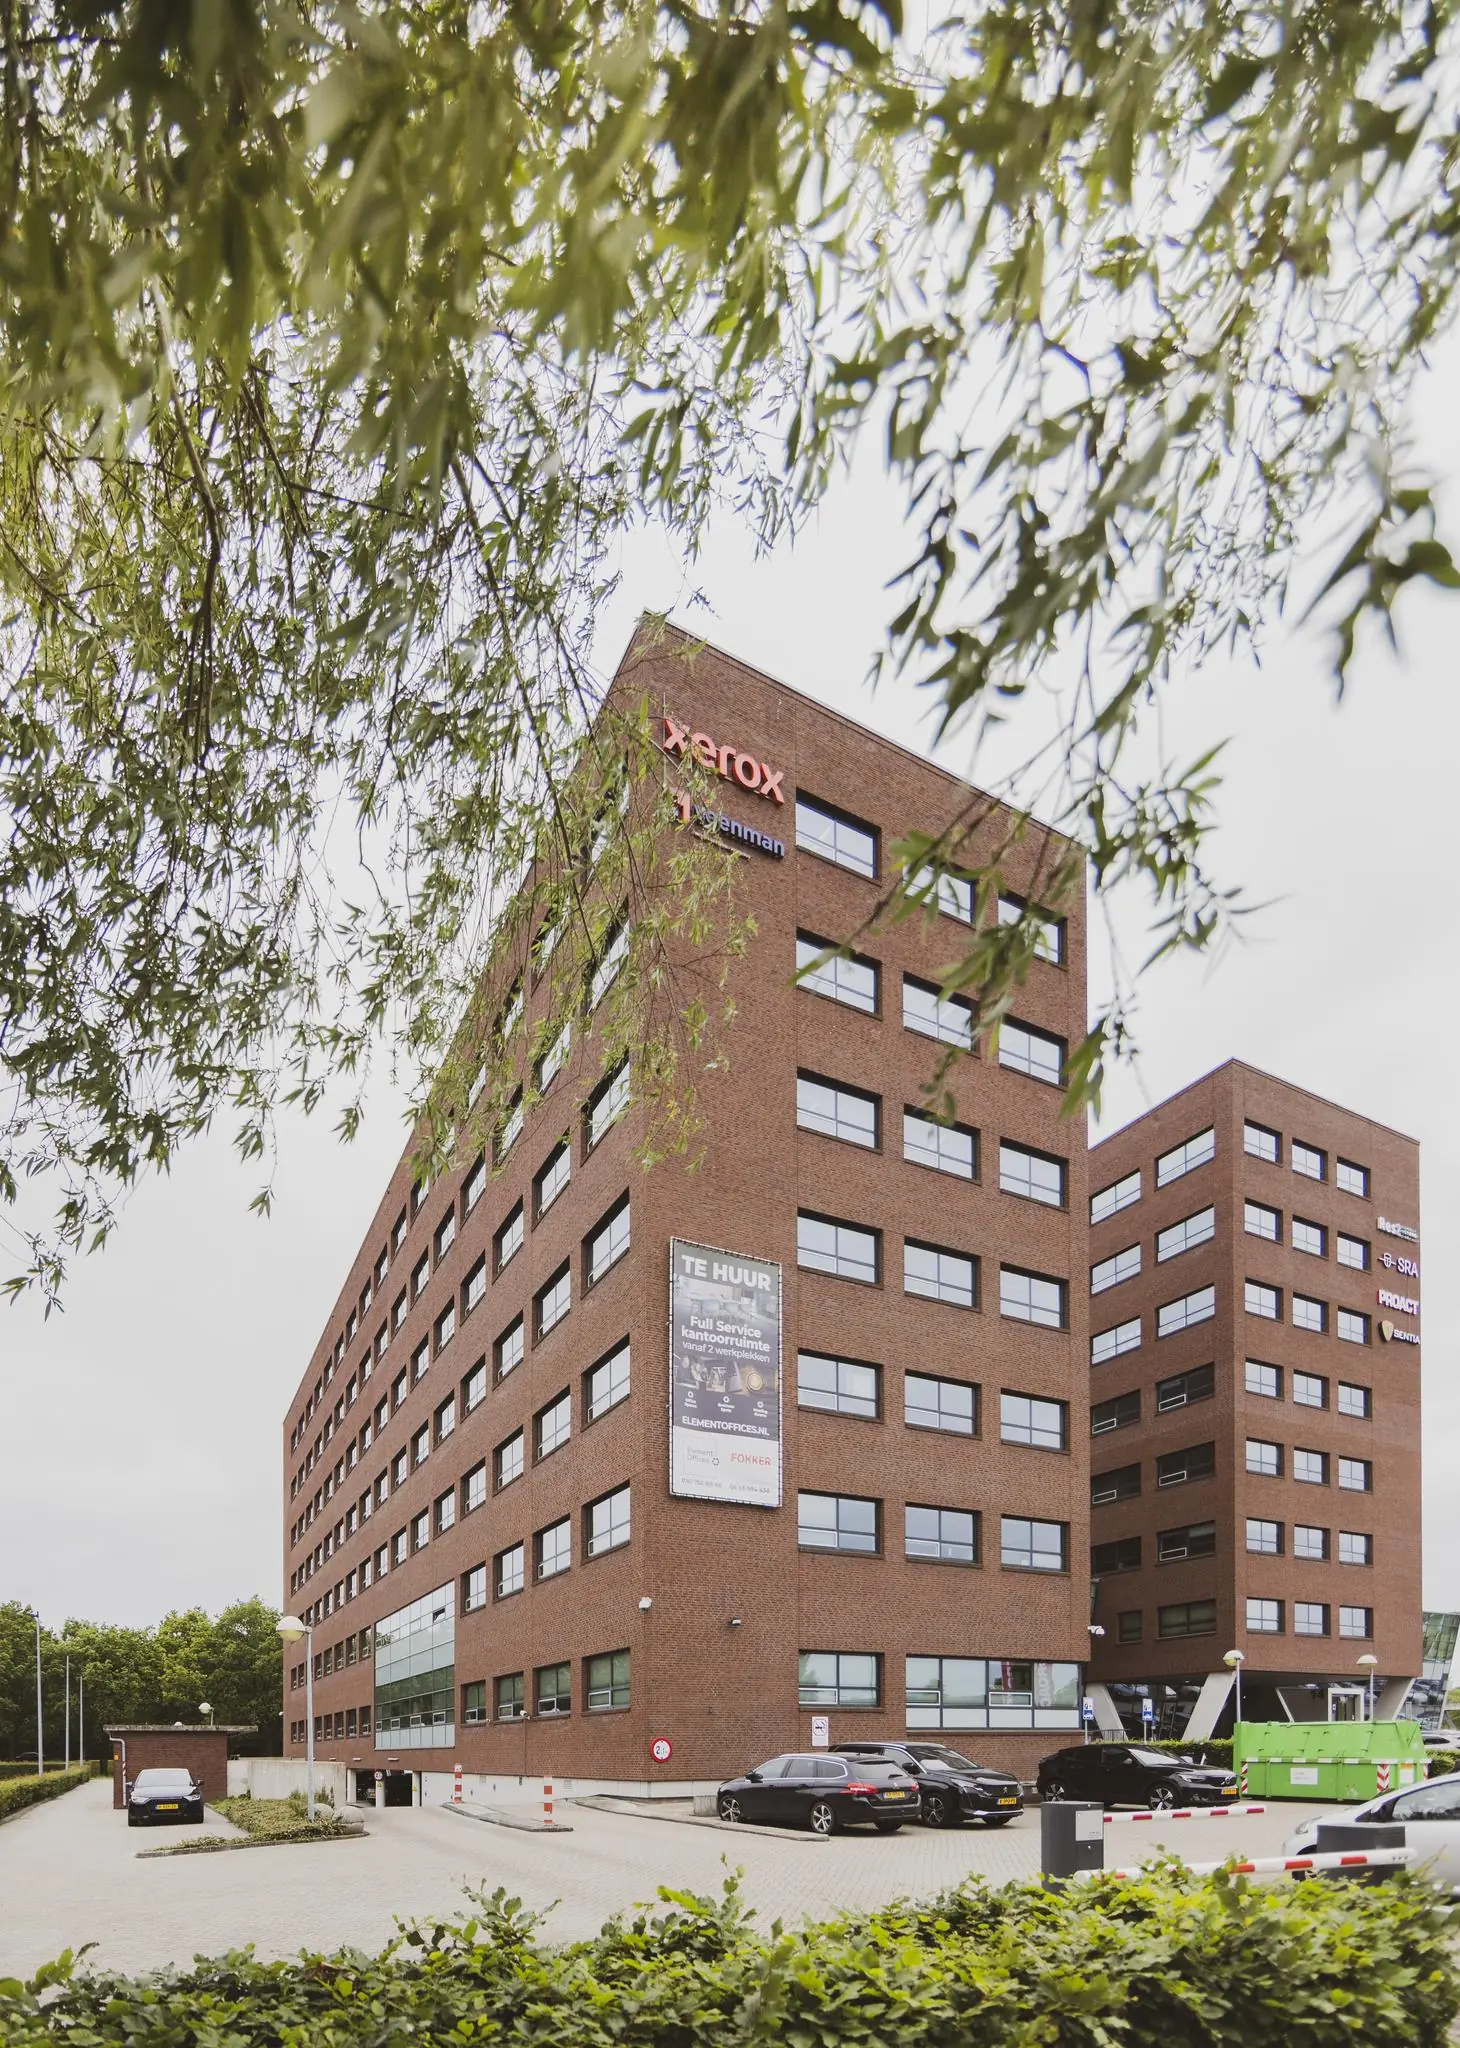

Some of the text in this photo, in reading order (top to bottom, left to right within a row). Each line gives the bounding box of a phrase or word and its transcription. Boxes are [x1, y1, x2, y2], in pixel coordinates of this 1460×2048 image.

[663, 718, 785, 807] xerox
[681, 1254, 771, 1292] TE HUUR
[1397, 1257, 1419, 1278] SRA
[1377, 1289, 1419, 1315] PROACT
[690, 1316, 761, 1338] Full Service
[1393, 1328, 1420, 1345] SENTIA
[681, 1325, 770, 1352] kantoorruimte
[682, 1341, 770, 1363] vanaf 2 werkplekken
[681, 1415, 770, 1436] ELEMENTOFFICES.NL
[730, 1453, 772, 1467] FOKKER
